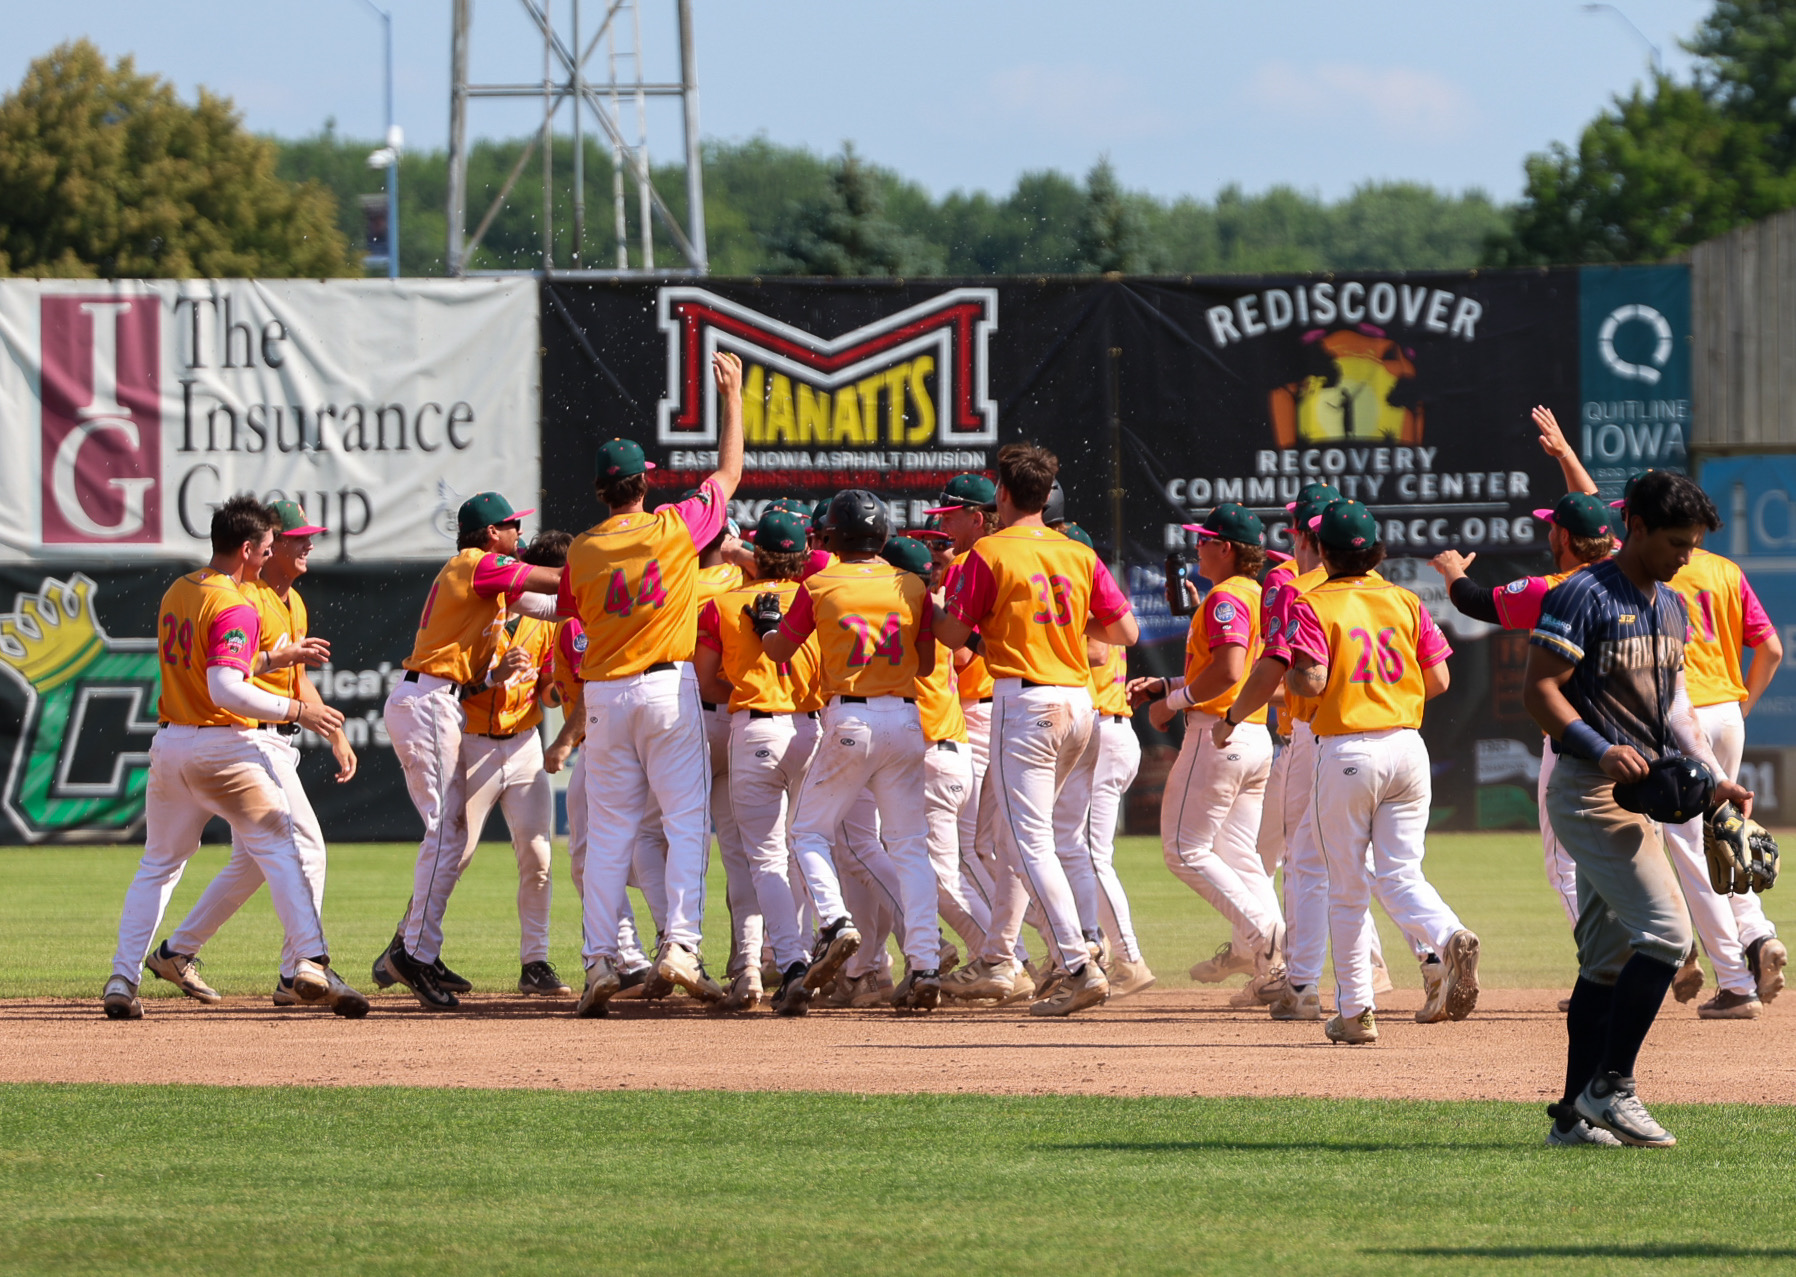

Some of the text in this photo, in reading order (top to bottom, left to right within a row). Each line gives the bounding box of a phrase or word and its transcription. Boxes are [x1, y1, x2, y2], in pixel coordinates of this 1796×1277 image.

[175, 292, 288, 370] The
[1205, 281, 1484, 348] REDISCOVER
[176, 378, 476, 454] Insurance
[1582, 399, 1690, 423] QUITLINE
[669, 450, 987, 471] EASTN IOWA ASPHALT DIVISION
[1255, 446, 1438, 477] RECOVERY
[1582, 423, 1688, 462] IOWA
[178, 462, 373, 563] Gup
[1399, 471, 1531, 500] CENTER
[603, 558, 669, 617] 44
[1030, 573, 1074, 626] 33
[162, 612, 194, 669] 29
[839, 612, 905, 668] 24
[1348, 625, 1405, 685] 26
